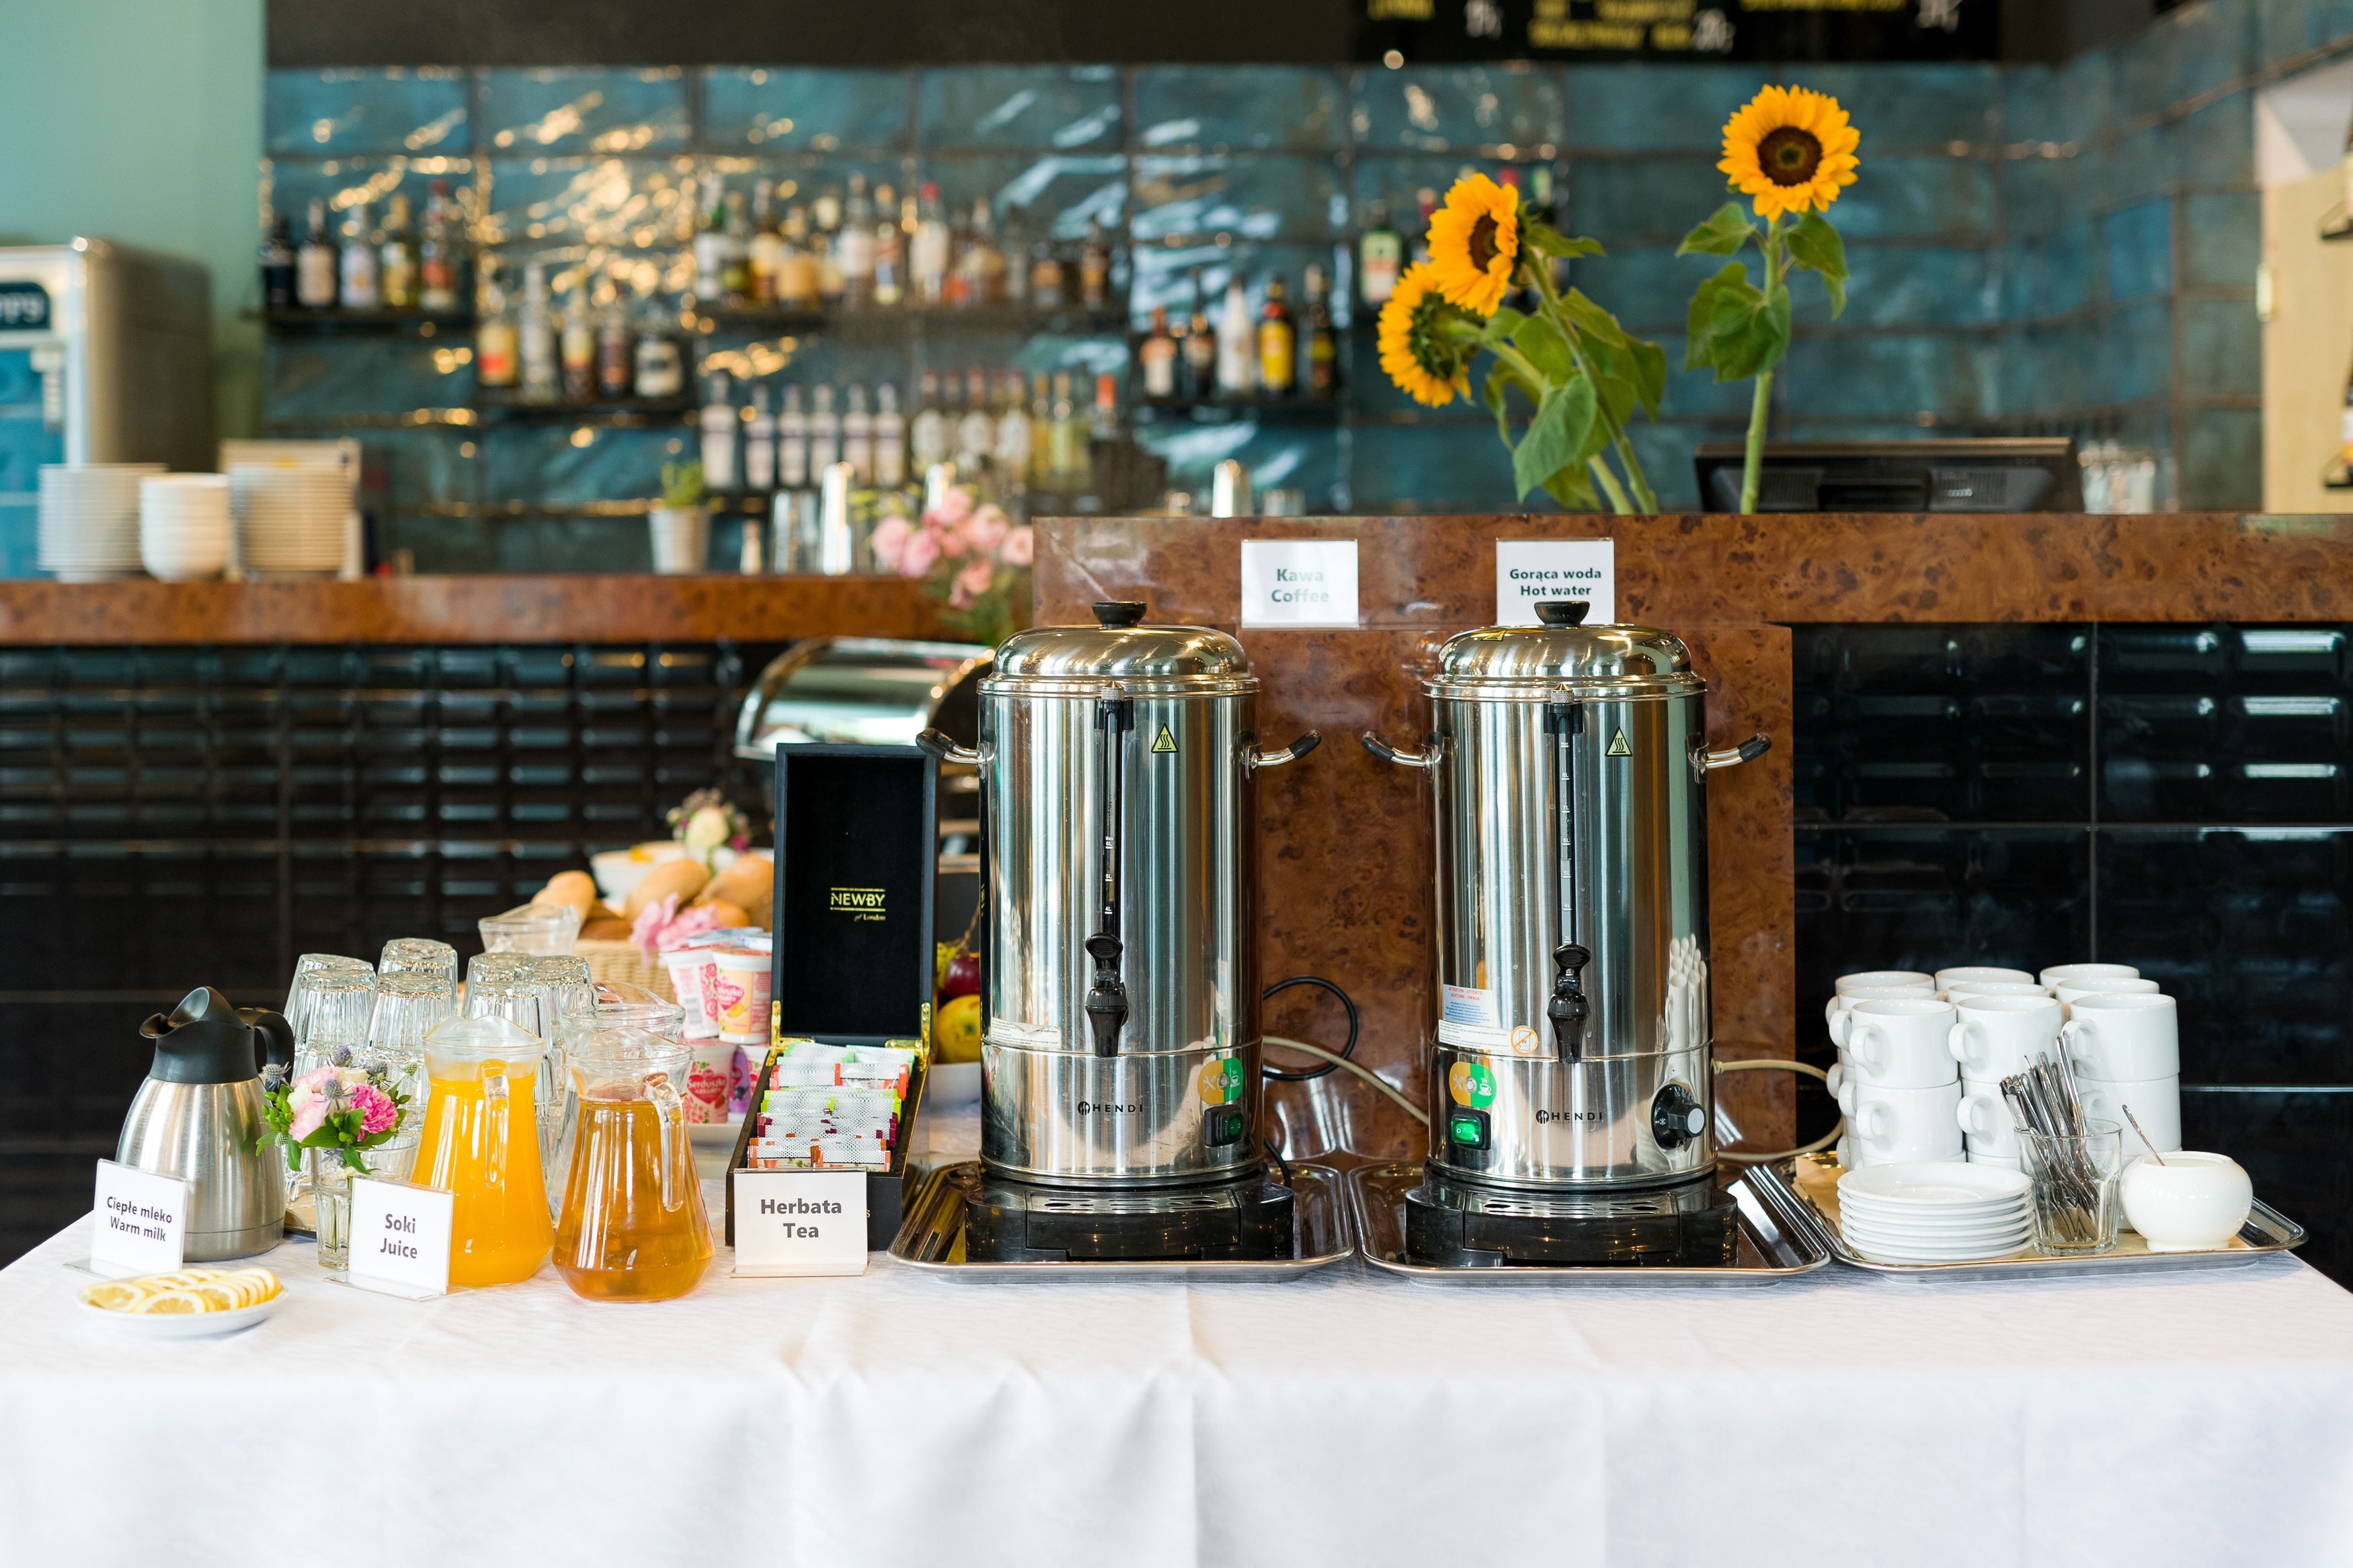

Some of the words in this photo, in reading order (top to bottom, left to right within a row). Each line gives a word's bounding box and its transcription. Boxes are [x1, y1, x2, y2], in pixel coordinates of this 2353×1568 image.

[1277, 568, 1324, 582] Kawa
[1509, 569, 1558, 582] Gorąca
[1563, 567, 1601, 579] woda
[1271, 588, 1329, 603] Coffee
[1521, 585, 1546, 596] Hot
[1551, 586, 1591, 595] water
[830, 892, 885, 907] NEWBY
[1092, 1104, 1143, 1113] HENDI
[1551, 1112, 1602, 1120] HENDI
[107, 1196, 137, 1216] Ciepłe
[141, 1206, 172, 1223] mleko
[760, 1198, 842, 1214] Herbata
[110, 1215, 140, 1235] Warm
[143, 1227, 166, 1242] milk
[385, 1213, 415, 1234] Soki
[783, 1223, 819, 1238] Tea
[380, 1237, 417, 1260] Juice
